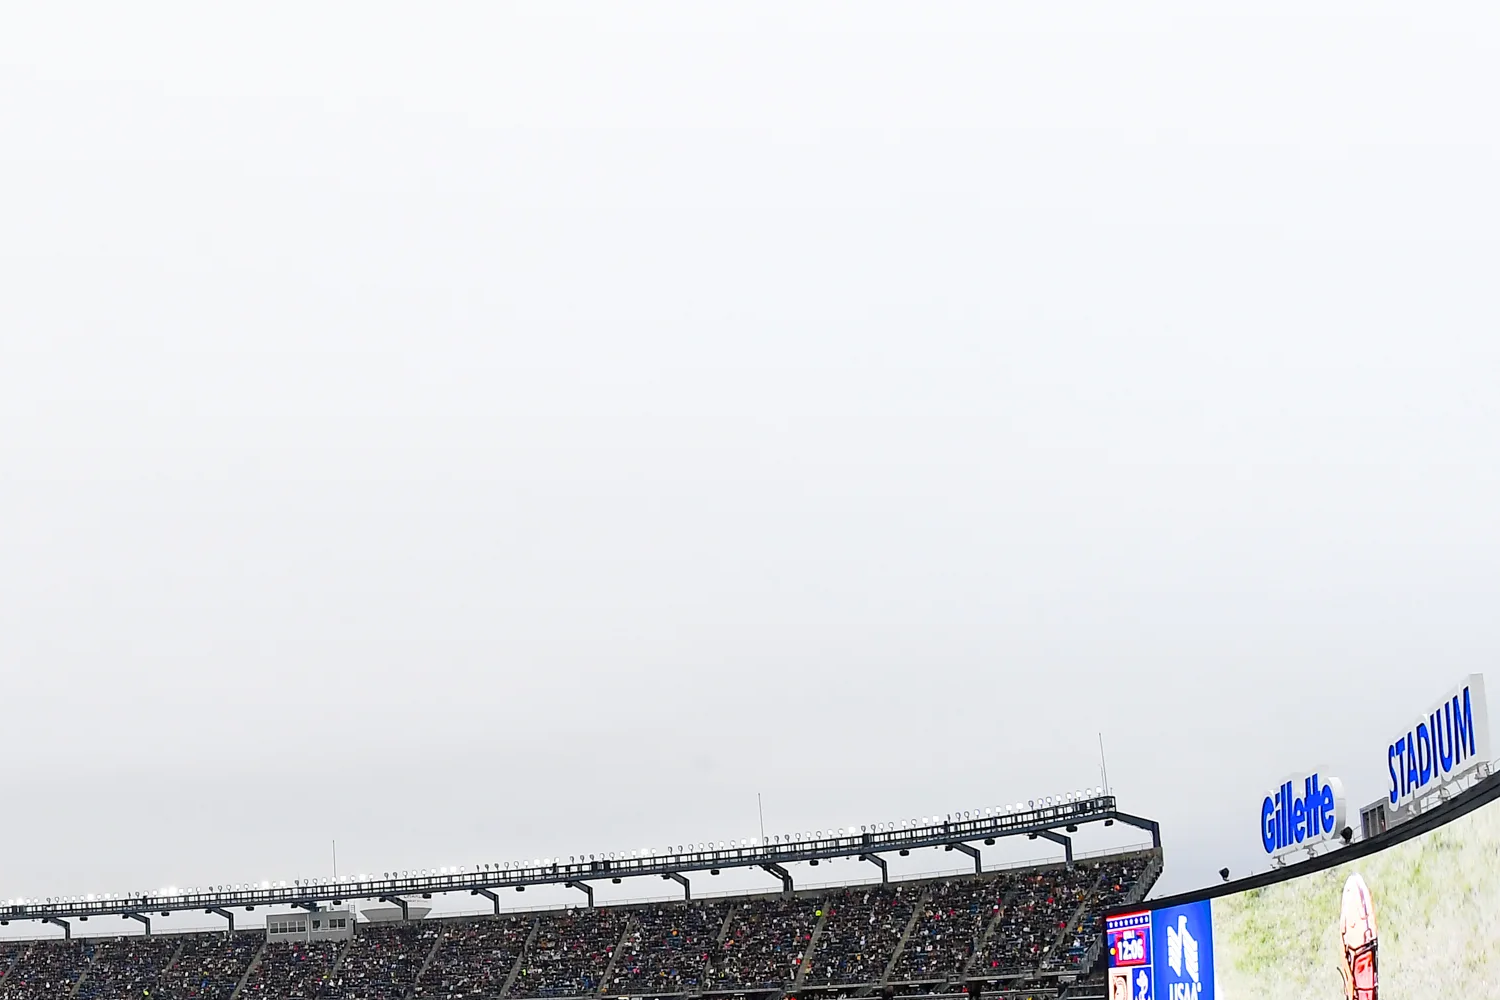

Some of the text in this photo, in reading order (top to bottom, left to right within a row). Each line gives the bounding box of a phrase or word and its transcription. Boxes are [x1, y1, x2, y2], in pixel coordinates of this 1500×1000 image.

[1387, 685, 1476, 804] STADIUM
[1261, 773, 1335, 854] Gillette
[1117, 938, 1144, 962] 12:06
